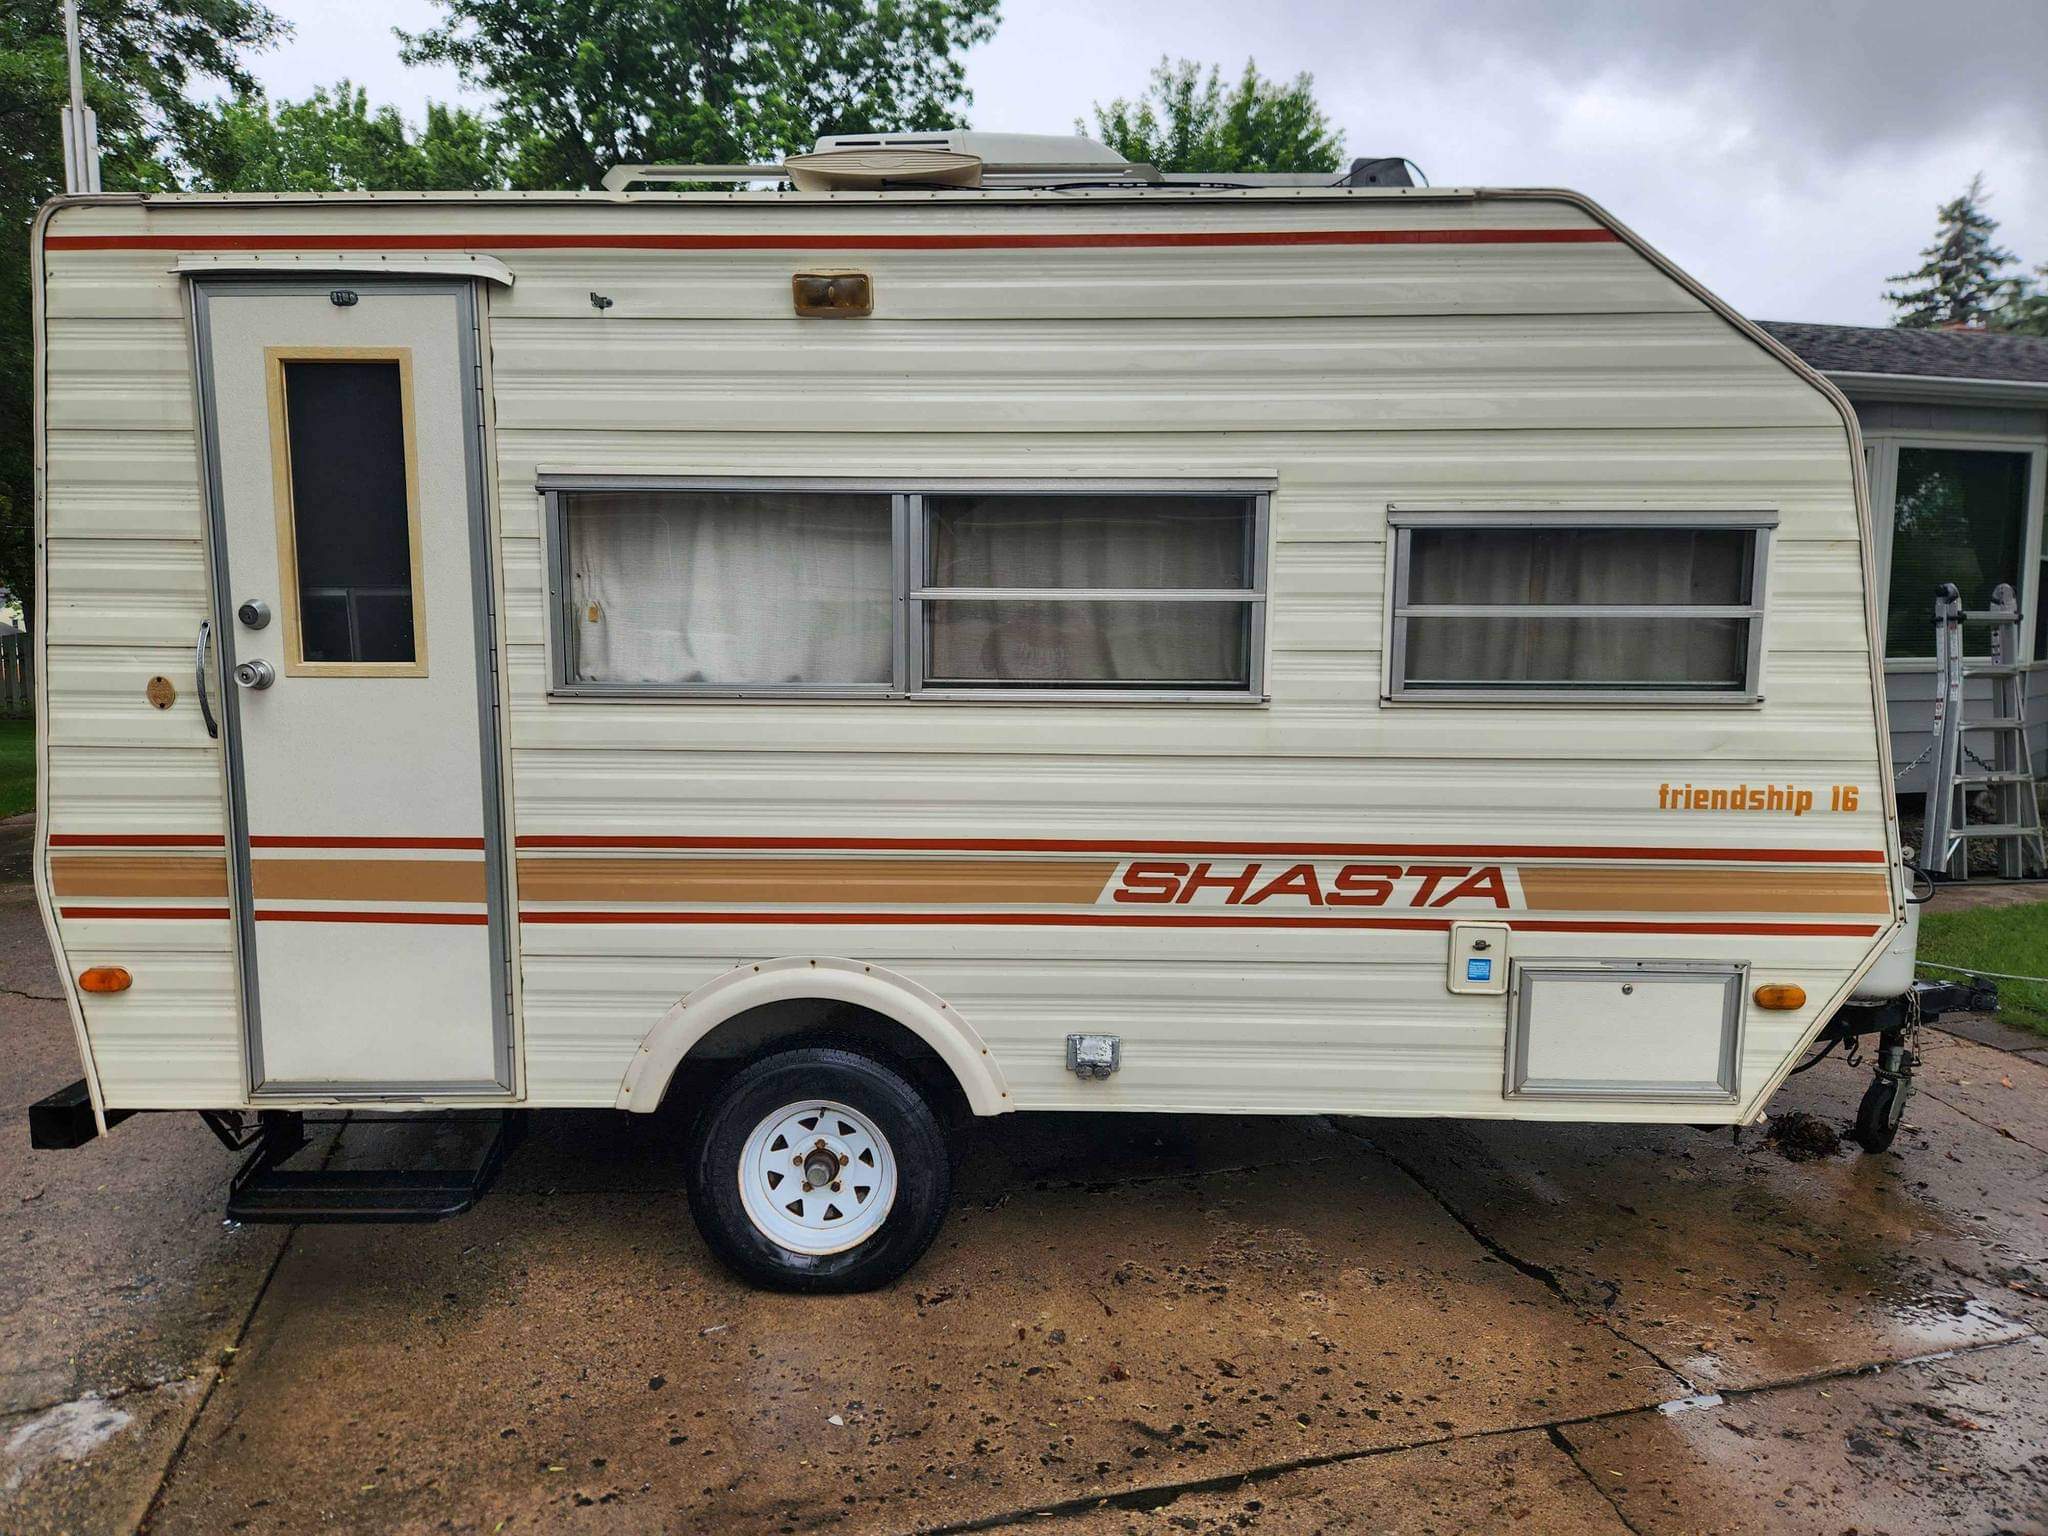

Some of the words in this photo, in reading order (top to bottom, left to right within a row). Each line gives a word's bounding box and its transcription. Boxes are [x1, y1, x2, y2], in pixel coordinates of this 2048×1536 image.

[1659, 783, 1813, 816] friendship
[1831, 785, 1859, 812] 16
[1113, 861, 1510, 909] SHASTA
